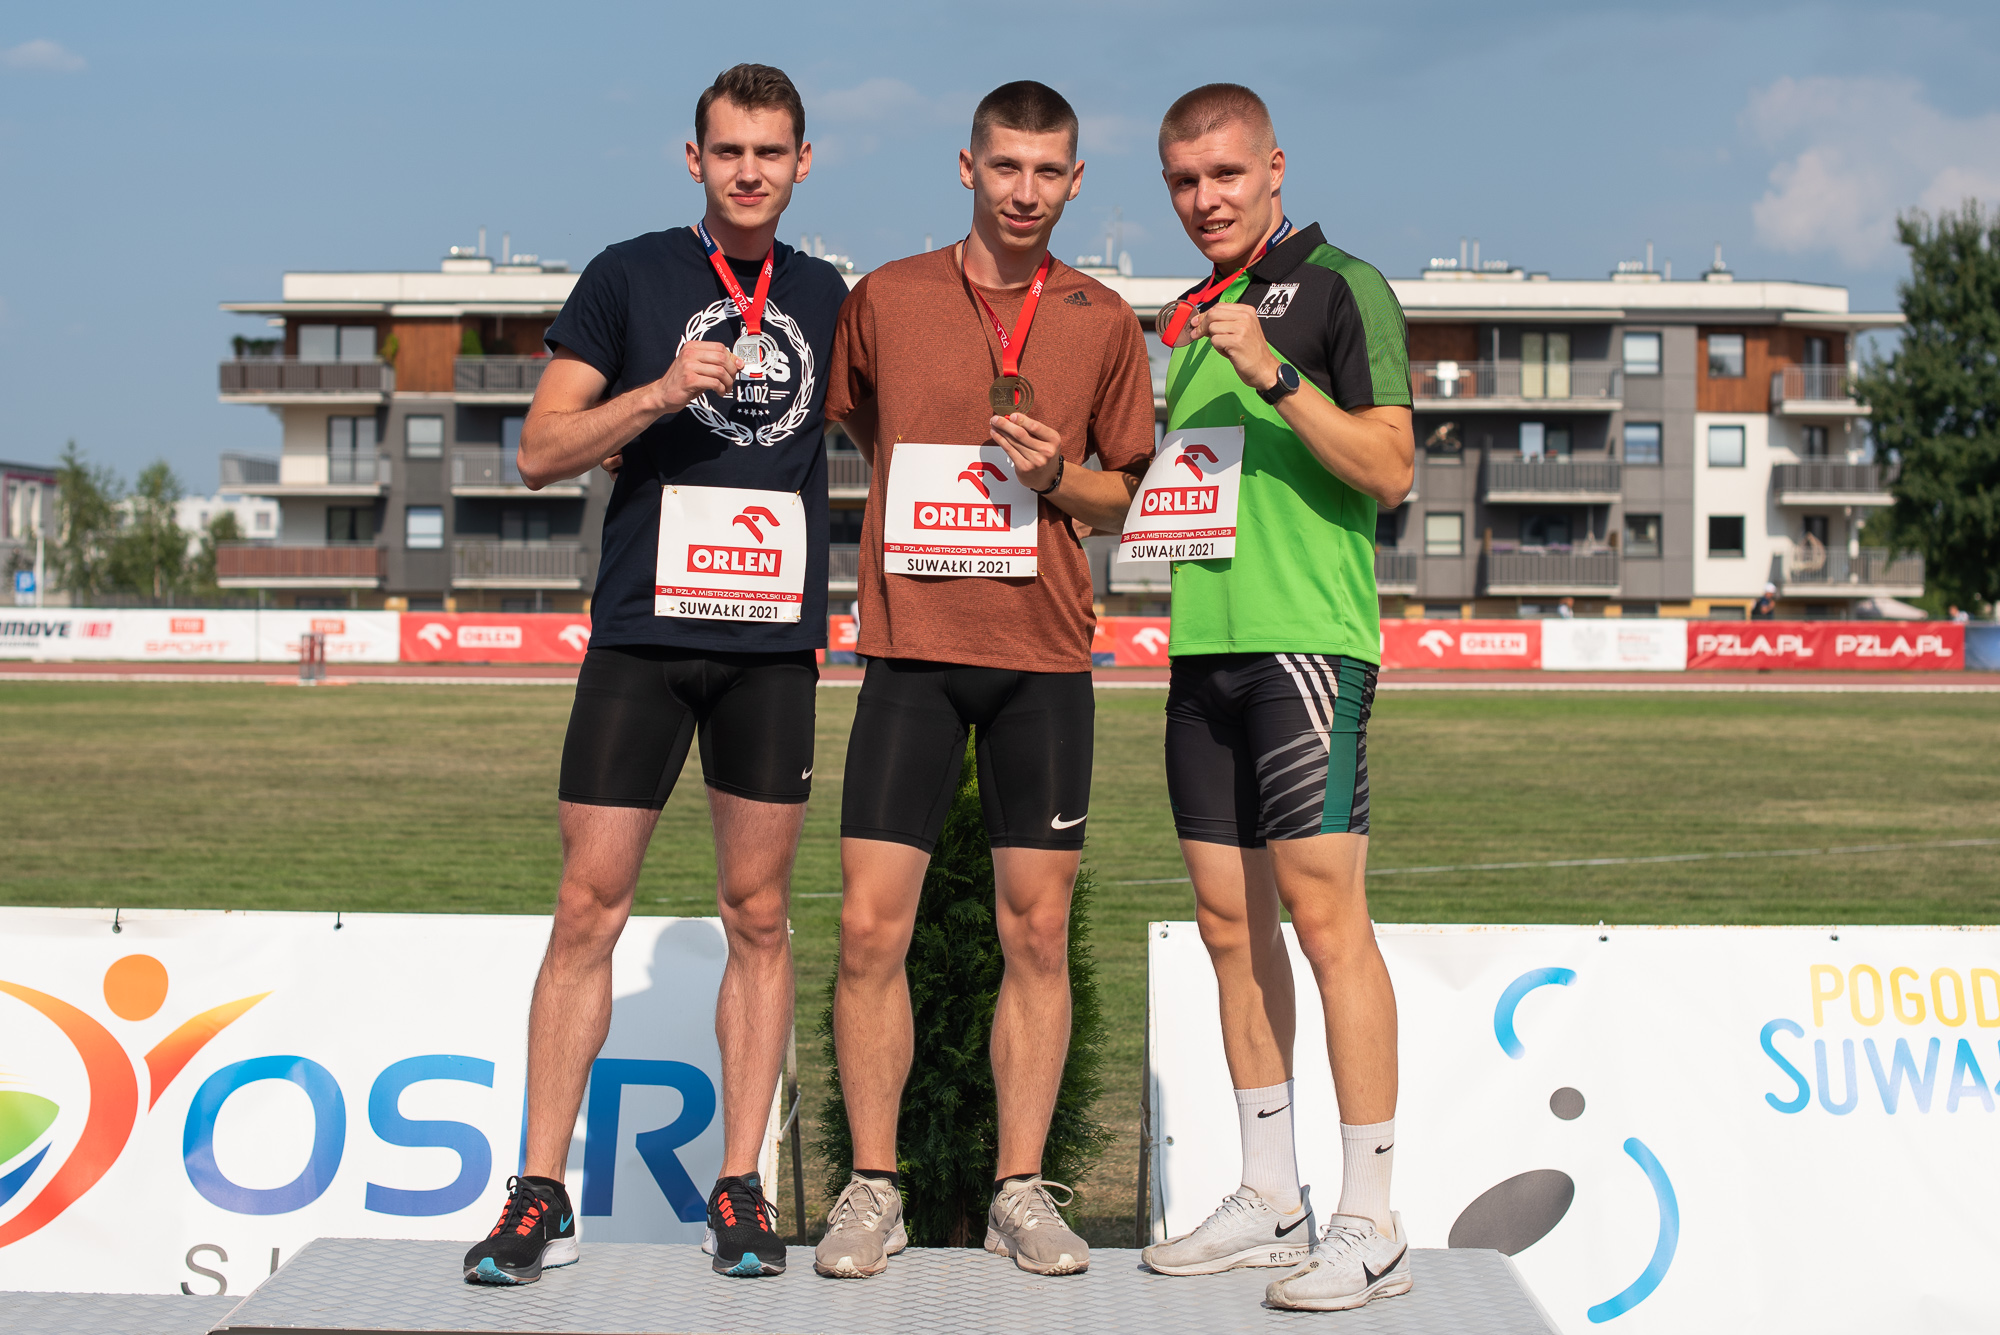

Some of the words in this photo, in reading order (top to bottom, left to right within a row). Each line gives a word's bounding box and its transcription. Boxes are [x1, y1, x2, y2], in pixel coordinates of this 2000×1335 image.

[734, 290, 750, 312] PZLA
[1063, 297, 1092, 306] adidas
[997, 322, 1010, 348] PZLA
[737, 383, 769, 404] ŁÓDŹ
[1144, 490, 1214, 513] ORLEN
[919, 505, 1005, 528] ORLEN
[1147, 531, 1195, 539] MISTRZOSTWA
[1195, 529, 1217, 537] POLSKI
[692, 548, 776, 573] ORLEN
[925, 547, 984, 555] MISTRZOSTWA
[1131, 544, 1186, 559] SUWAŁKI
[1188, 543, 1215, 556] 2021
[907, 558, 972, 573] SUWAŁKI
[977, 561, 1011, 574] 2021
[675, 588, 697, 596] PZLA
[698, 590, 755, 599] MISTRZOSTWA
[679, 601, 744, 617] SUWAŁKI
[748, 605, 778, 619] 2021
[462, 632, 516, 642] ORLEN
[1465, 637, 1521, 649] ORLEN
[1697, 634, 1813, 656] PZLA.PL
[1836, 635, 1952, 657] PZLA.PL
[1759, 1018, 2000, 1116] SUWA
[183, 1054, 717, 1223] OSR
